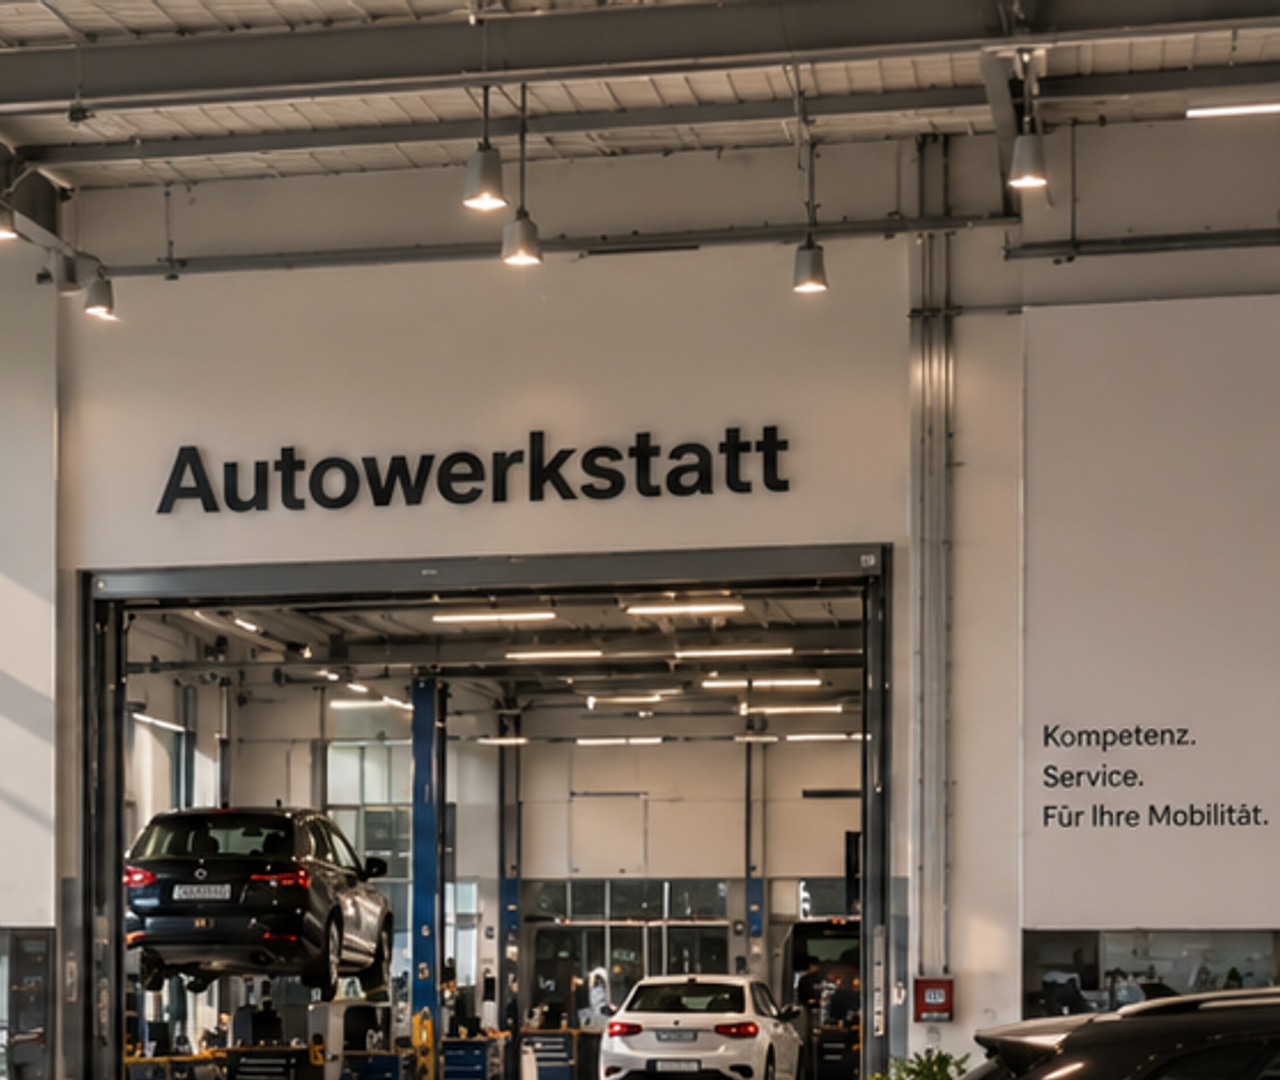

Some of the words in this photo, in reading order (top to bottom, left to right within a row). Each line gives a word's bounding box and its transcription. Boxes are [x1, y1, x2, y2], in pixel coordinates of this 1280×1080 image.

[156, 425, 790, 515] Autowerkstatt
[1043, 724, 1197, 752] Kompetenz.
[1043, 764, 1144, 789] Service.
[1043, 805, 1086, 828] Für
[1091, 804, 1141, 828] Ihre
[1148, 803, 1270, 827] Mobilität.
